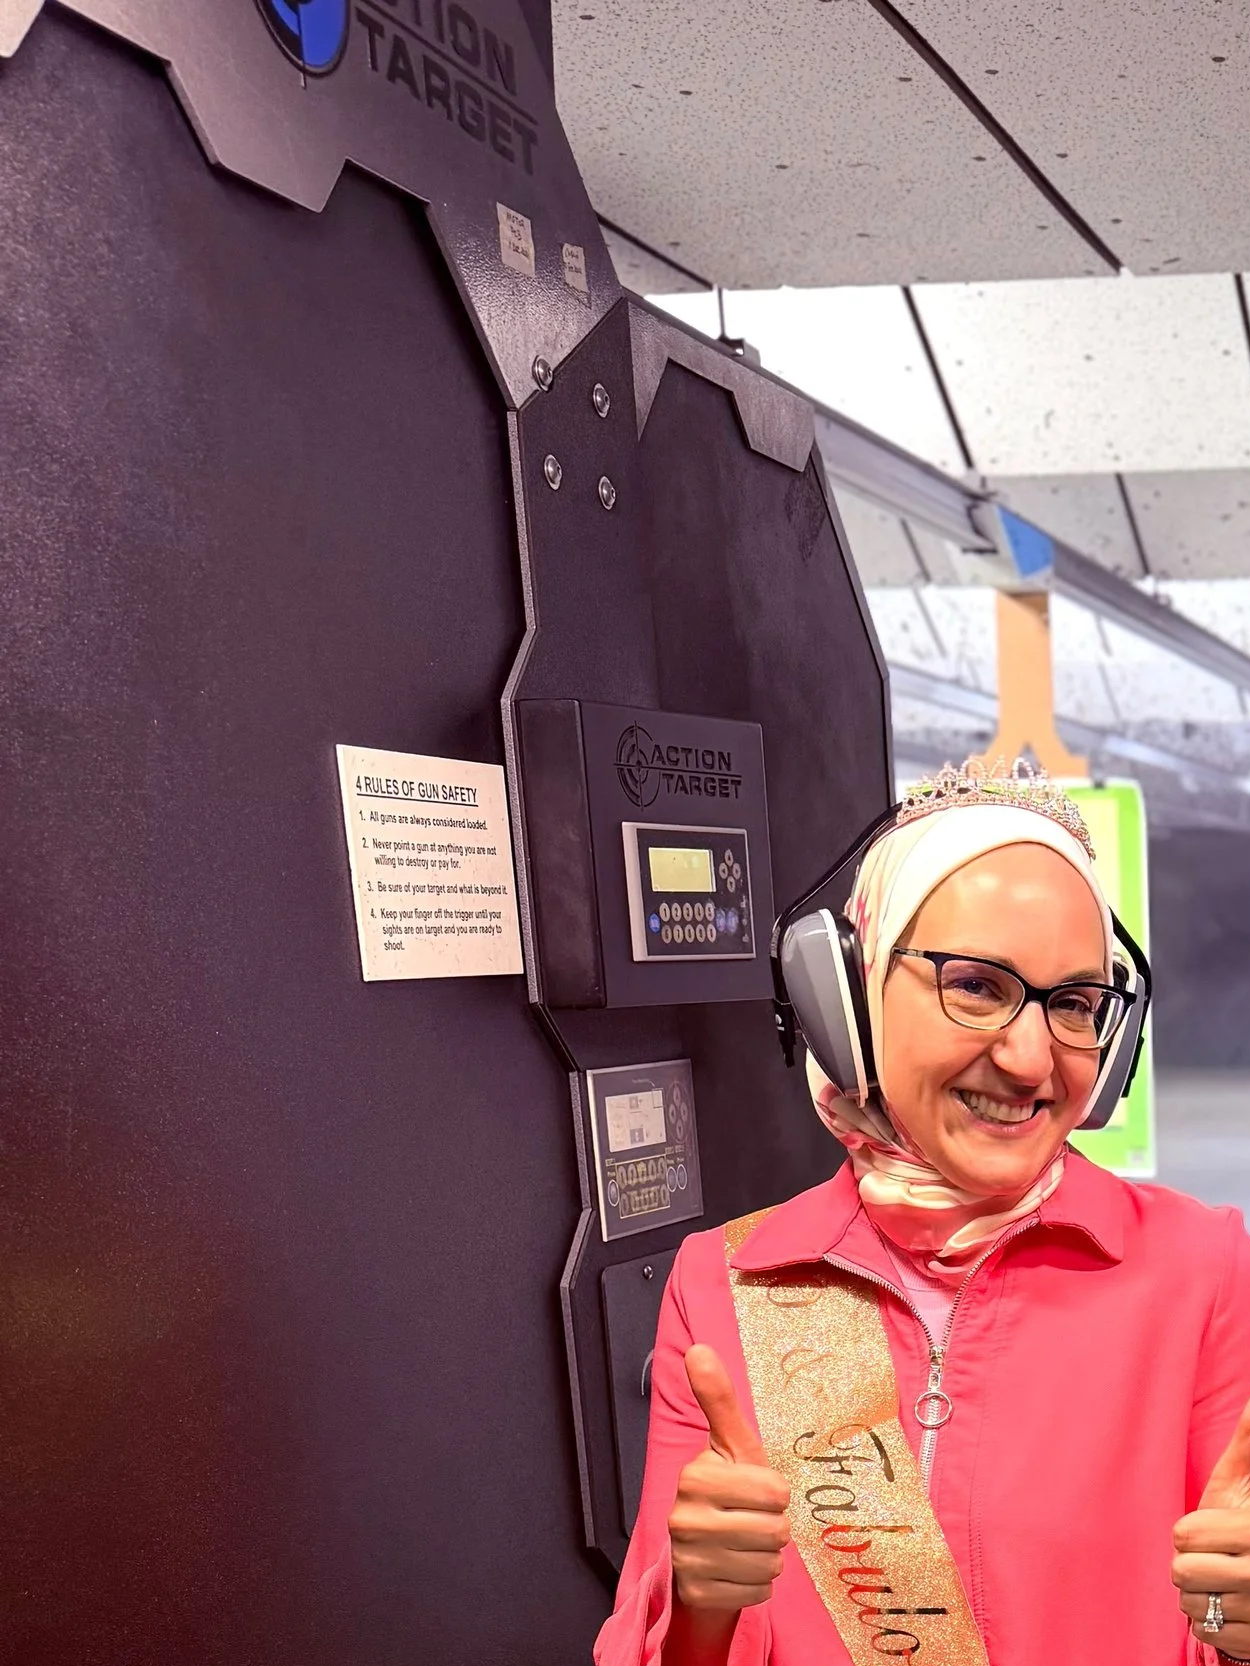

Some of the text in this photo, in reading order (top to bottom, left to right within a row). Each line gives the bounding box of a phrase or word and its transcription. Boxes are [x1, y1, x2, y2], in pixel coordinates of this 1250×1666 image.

[355, 6, 538, 176] TARGET
[651, 744, 732, 772] ACTION
[356, 775, 477, 803] 4 RULES OF GUN SAFETY
[662, 772, 742, 799] TARGET
[359, 810, 366, 821] 1.
[370, 811, 379, 822] All
[380, 813, 397, 825] guns
[398, 815, 409, 824] are
[410, 814, 431, 828] always
[362, 837, 369, 849] 2.
[372, 838, 392, 850] Never
[393, 840, 410, 854] point
[416, 844, 429, 854] gun
[430, 843, 437, 852] at
[437, 843, 464, 856] anything
[464, 846, 476, 857] you
[476, 846, 486, 855] are
[486, 845, 497, 856] not
[374, 854, 461, 870] willing to destroy or pay for.
[367, 880, 374, 892] 3.
[377, 881, 387, 892] Be
[388, 884, 402, 893] sure
[403, 882, 411, 893] of
[411, 884, 426, 895] your
[427, 883, 446, 895] target
[446, 884, 458, 894] and
[458, 884, 473, 894] what
[473, 884, 480, 894] is
[480, 885, 501, 896] beyond
[370, 908, 502, 921] 4. Keep your finger off the trigger until your
[382, 924, 502, 937] sights are on target and you are ready to
[384, 940, 405, 950] shoot.
